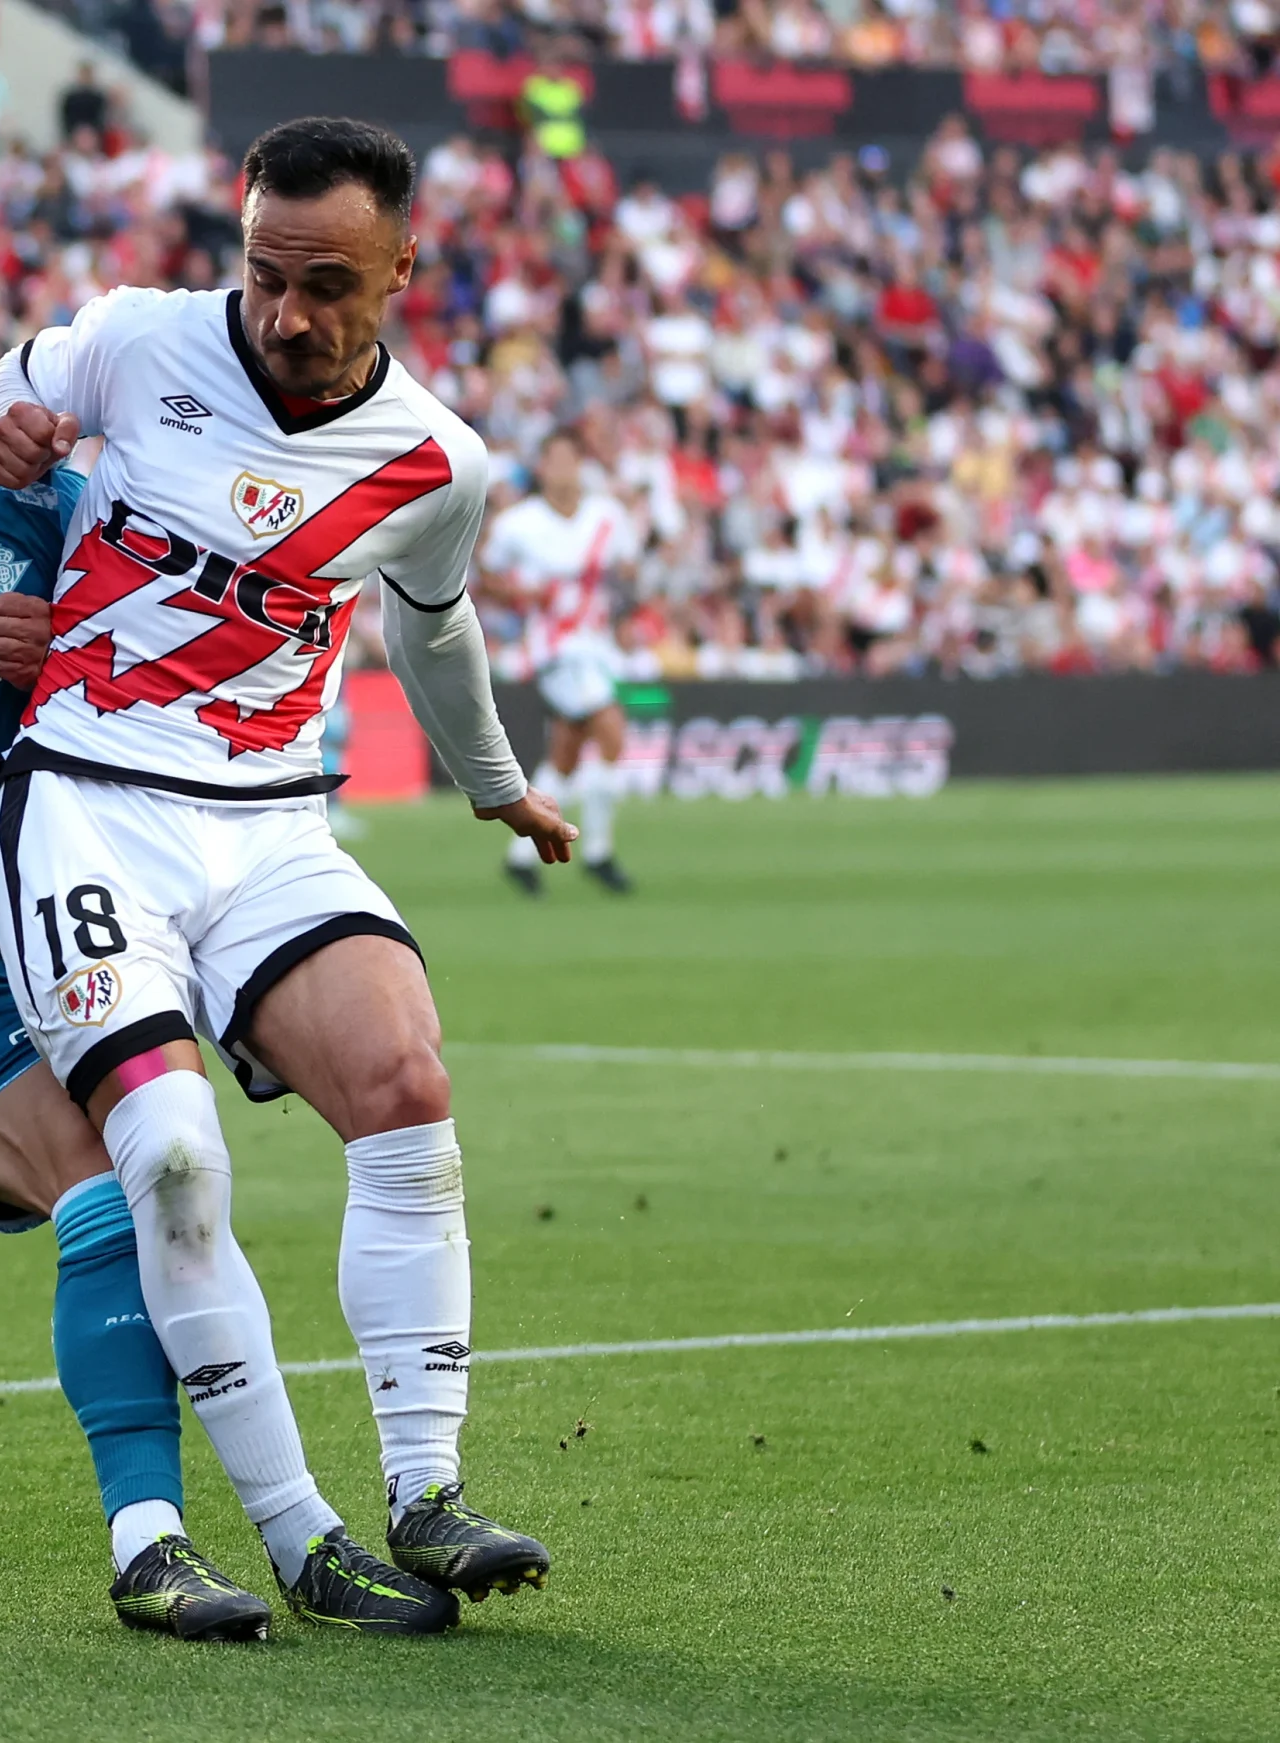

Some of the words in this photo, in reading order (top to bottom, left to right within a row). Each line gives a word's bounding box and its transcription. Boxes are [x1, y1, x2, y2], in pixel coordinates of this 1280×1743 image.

[159, 415, 203, 436] umbro
[33, 883, 128, 981] 18
[104, 1312, 152, 1327] REA
